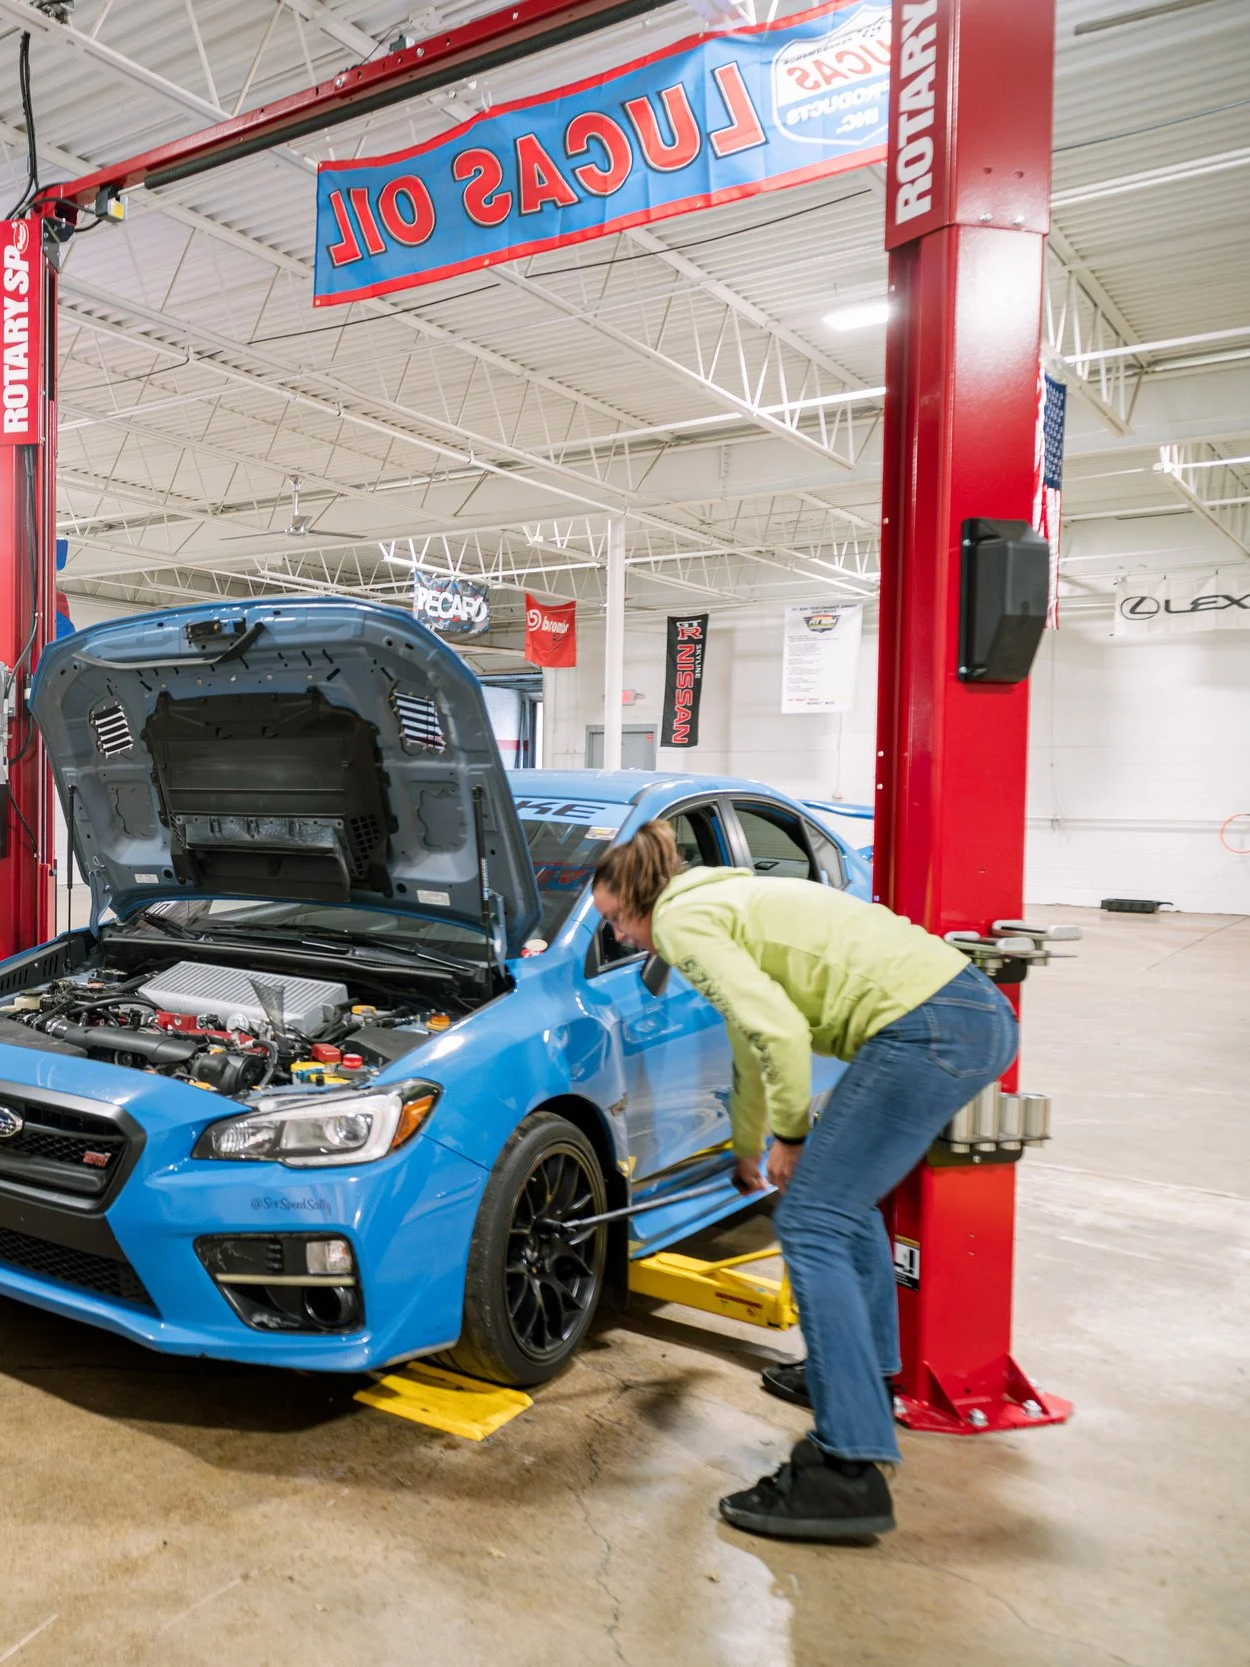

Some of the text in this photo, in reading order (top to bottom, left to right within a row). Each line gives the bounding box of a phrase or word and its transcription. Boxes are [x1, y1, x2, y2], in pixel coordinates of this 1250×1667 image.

[895, 0, 938, 225] ROTARY
[3, 245, 30, 295] SP
[3, 297, 29, 433] ROTARY
[1164, 594, 1250, 614] LEX
[694, 643, 703, 679] SKYLINE
[671, 643, 696, 744] NISSAN
[515, 800, 607, 819] KE
